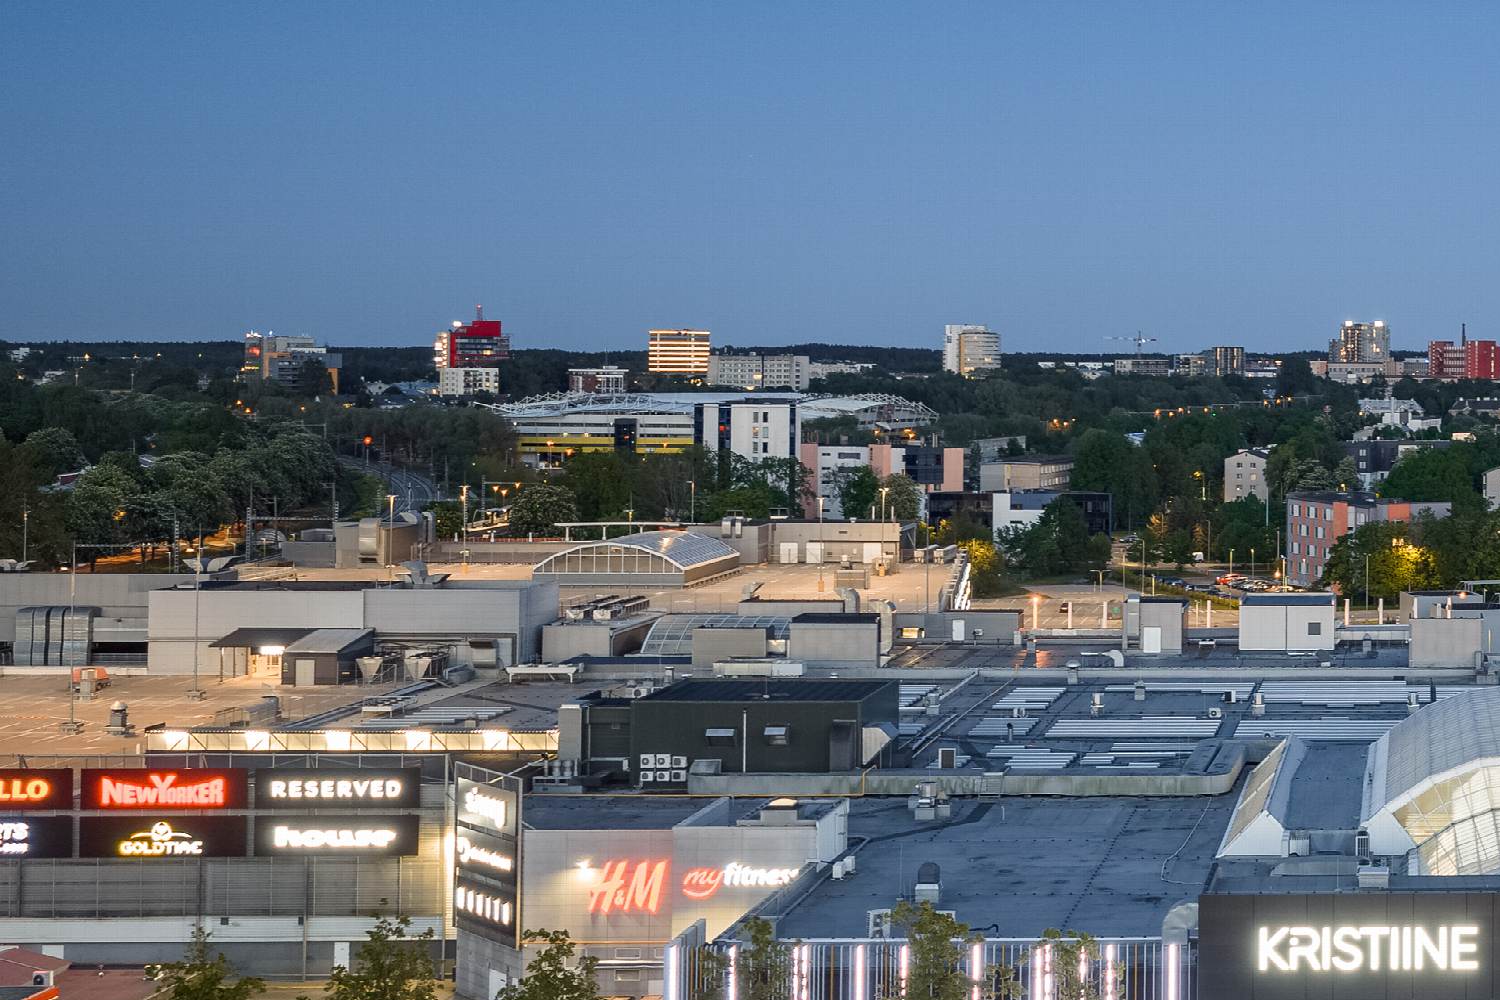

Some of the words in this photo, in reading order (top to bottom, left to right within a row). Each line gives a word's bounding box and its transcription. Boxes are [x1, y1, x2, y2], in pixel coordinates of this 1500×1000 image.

[271, 780, 402, 798] RESERVED
[588, 859, 668, 914] H&M
[1259, 926, 1479, 971] KRISTIINE
